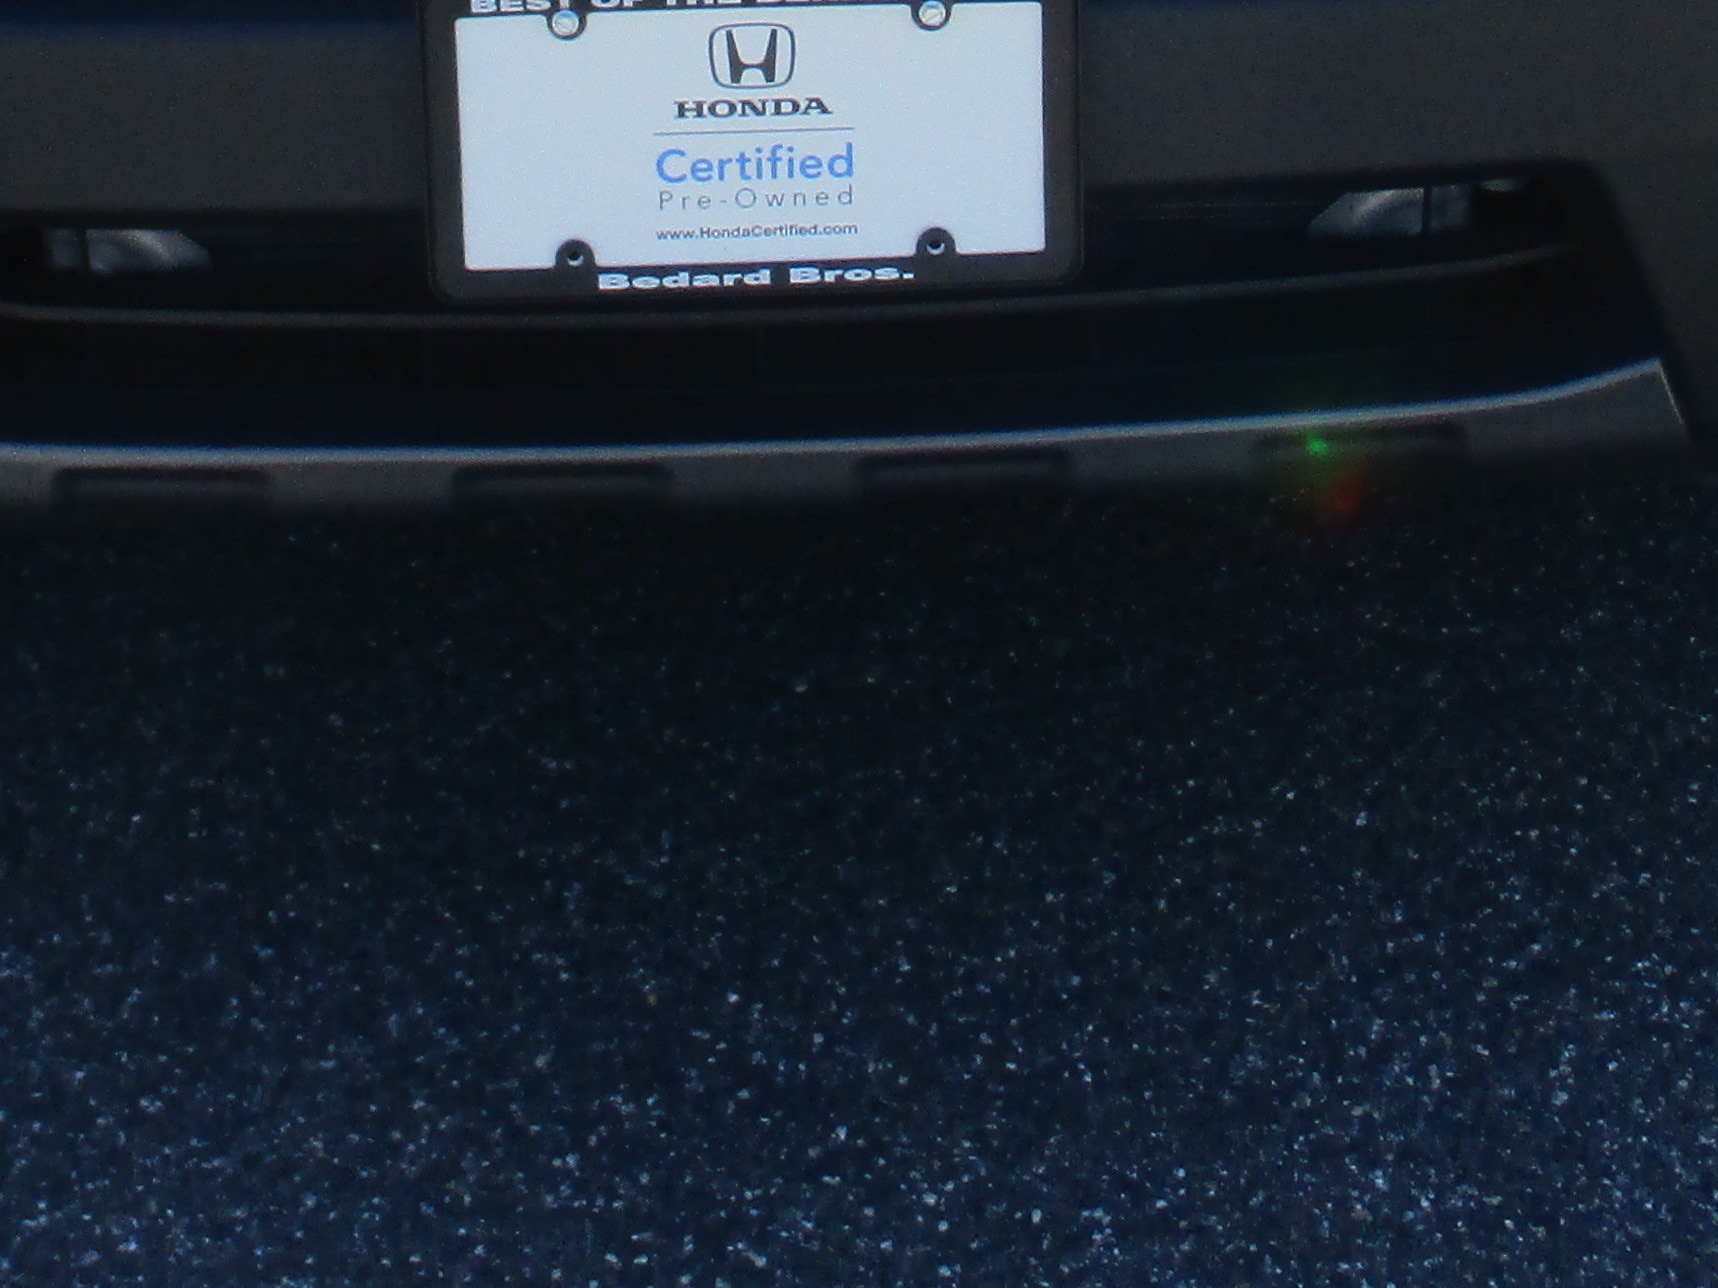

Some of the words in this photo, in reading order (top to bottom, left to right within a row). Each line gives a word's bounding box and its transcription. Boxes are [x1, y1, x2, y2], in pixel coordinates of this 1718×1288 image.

[674, 97, 834, 120] HONDA
[656, 142, 854, 183] Certified
[659, 184, 854, 211] Pre-Owned
[655, 224, 859, 241] www.HondaCertified.com
[789, 266, 916, 284] Bros.
